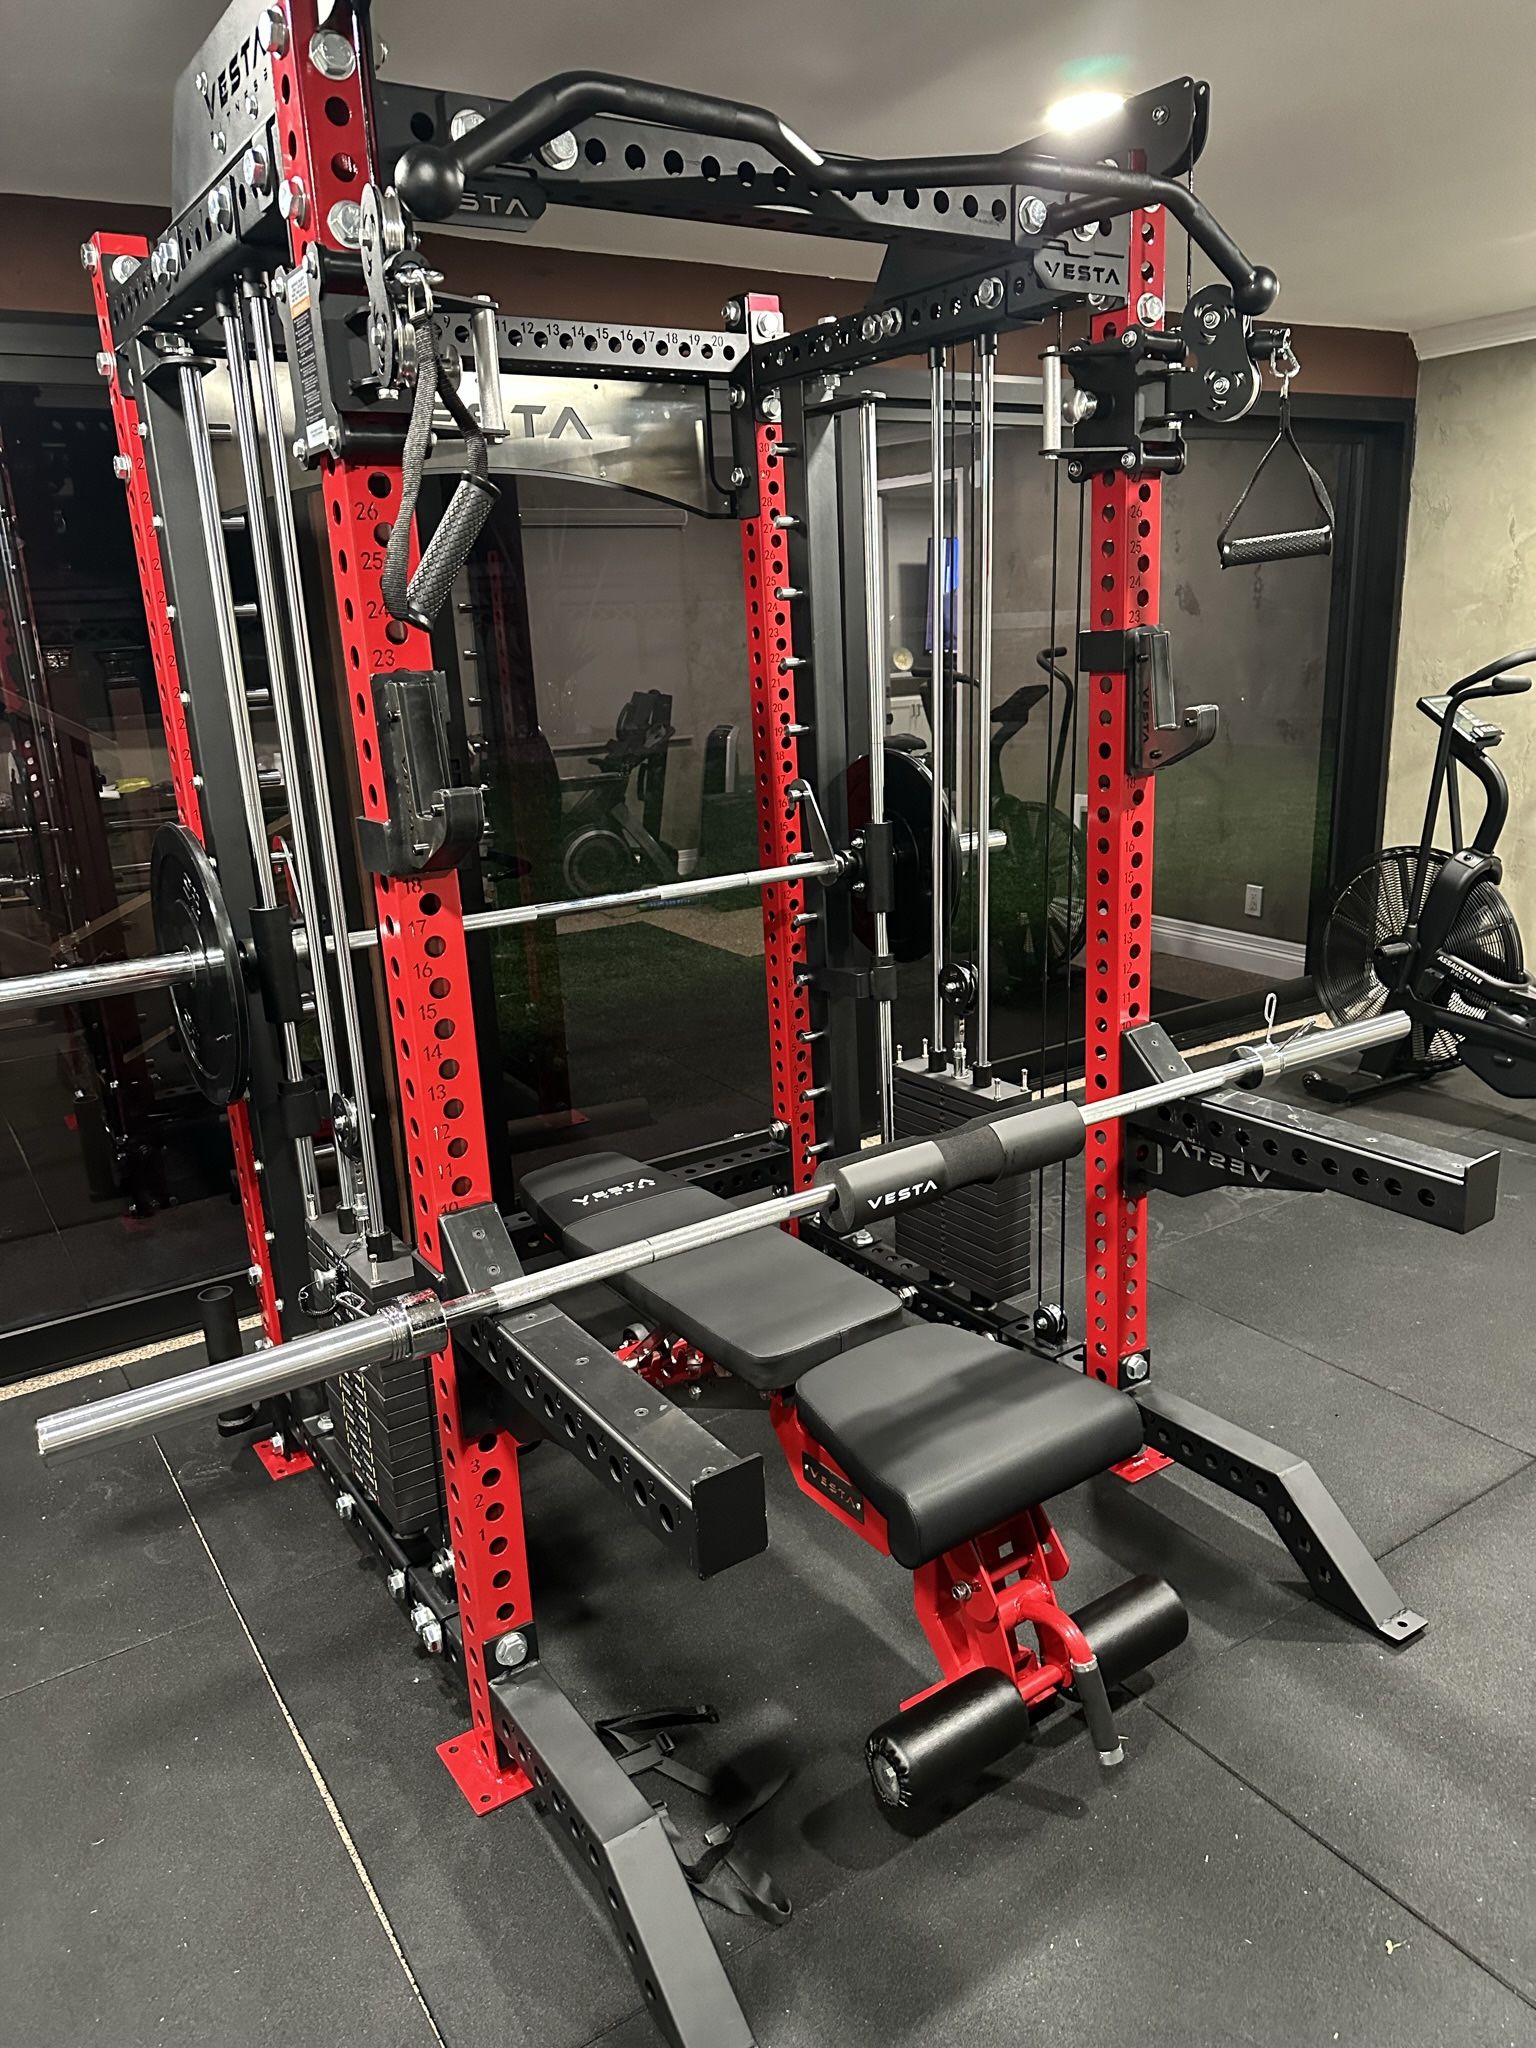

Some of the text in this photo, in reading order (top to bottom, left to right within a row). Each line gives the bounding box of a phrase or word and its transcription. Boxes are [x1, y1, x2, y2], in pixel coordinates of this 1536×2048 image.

[203, 25, 267, 120] VESTA
[459, 191, 529, 217] STA
[1044, 260, 1120, 285] VESTA
[444, 315, 451, 328] 9
[495, 320, 507, 332] 11
[521, 322, 534, 335] 12
[547, 323, 560, 336] 13
[572, 326, 585, 338] 14
[596, 327, 609, 339] 15
[620, 329, 634, 341] 16
[643, 330, 655, 342] 17
[666, 332, 678, 344] 18
[689, 334, 701, 345] 19
[712, 335, 724, 347] 20
[760, 443, 770, 453] 30
[760, 470, 770, 480] 29
[762, 497, 772, 507] 28
[354, 501, 379, 521] 26
[1130, 505, 1142, 518] 26
[763, 524, 773, 533] 27
[1130, 540, 1142, 554] 25
[360, 551, 383, 571] 25
[765, 550, 775, 560] 26
[766, 576, 776, 586] 25
[1129, 575, 1141, 588] 24
[367, 601, 389, 619] 24
[768, 602, 778, 612] 24
[1128, 610, 1140, 624] 23
[769, 628, 779, 637] 23
[373, 649, 395, 668] 23
[770, 654, 780, 663] 22
[771, 679, 780, 688] 21
[773, 703, 782, 712] 20
[775, 728, 783, 737] 19
[776, 751, 785, 760] 18
[777, 775, 786, 784] 17
[778, 799, 787, 808] 16
[1125, 808, 1136, 821] 17
[779, 822, 788, 831] 15
[1125, 840, 1135, 853] 16
[1125, 871, 1134, 884] 15
[404, 878, 423, 895] 18
[1124, 902, 1134, 914] 14
[408, 919, 427, 937] 17
[1123, 933, 1133, 945] 13
[413, 961, 433, 979] 16
[1123, 962, 1133, 975] 12
[1450, 969, 1465, 981] PRO
[1122, 991, 1131, 1003] 11
[418, 1003, 437, 1021] 15
[424, 1043, 442, 1062] 14
[428, 1083, 447, 1101] 13
[433, 1123, 451, 1141] 12
[438, 1162, 453, 1180] 11
[867, 1180, 938, 1210] VESTA
[470, 1458, 480, 1473] 3
[647, 1479, 656, 1500] 2
[810, 1465, 856, 1509] VESTA
[473, 1493, 485, 1508] 2
[479, 1527, 485, 1541] 1
